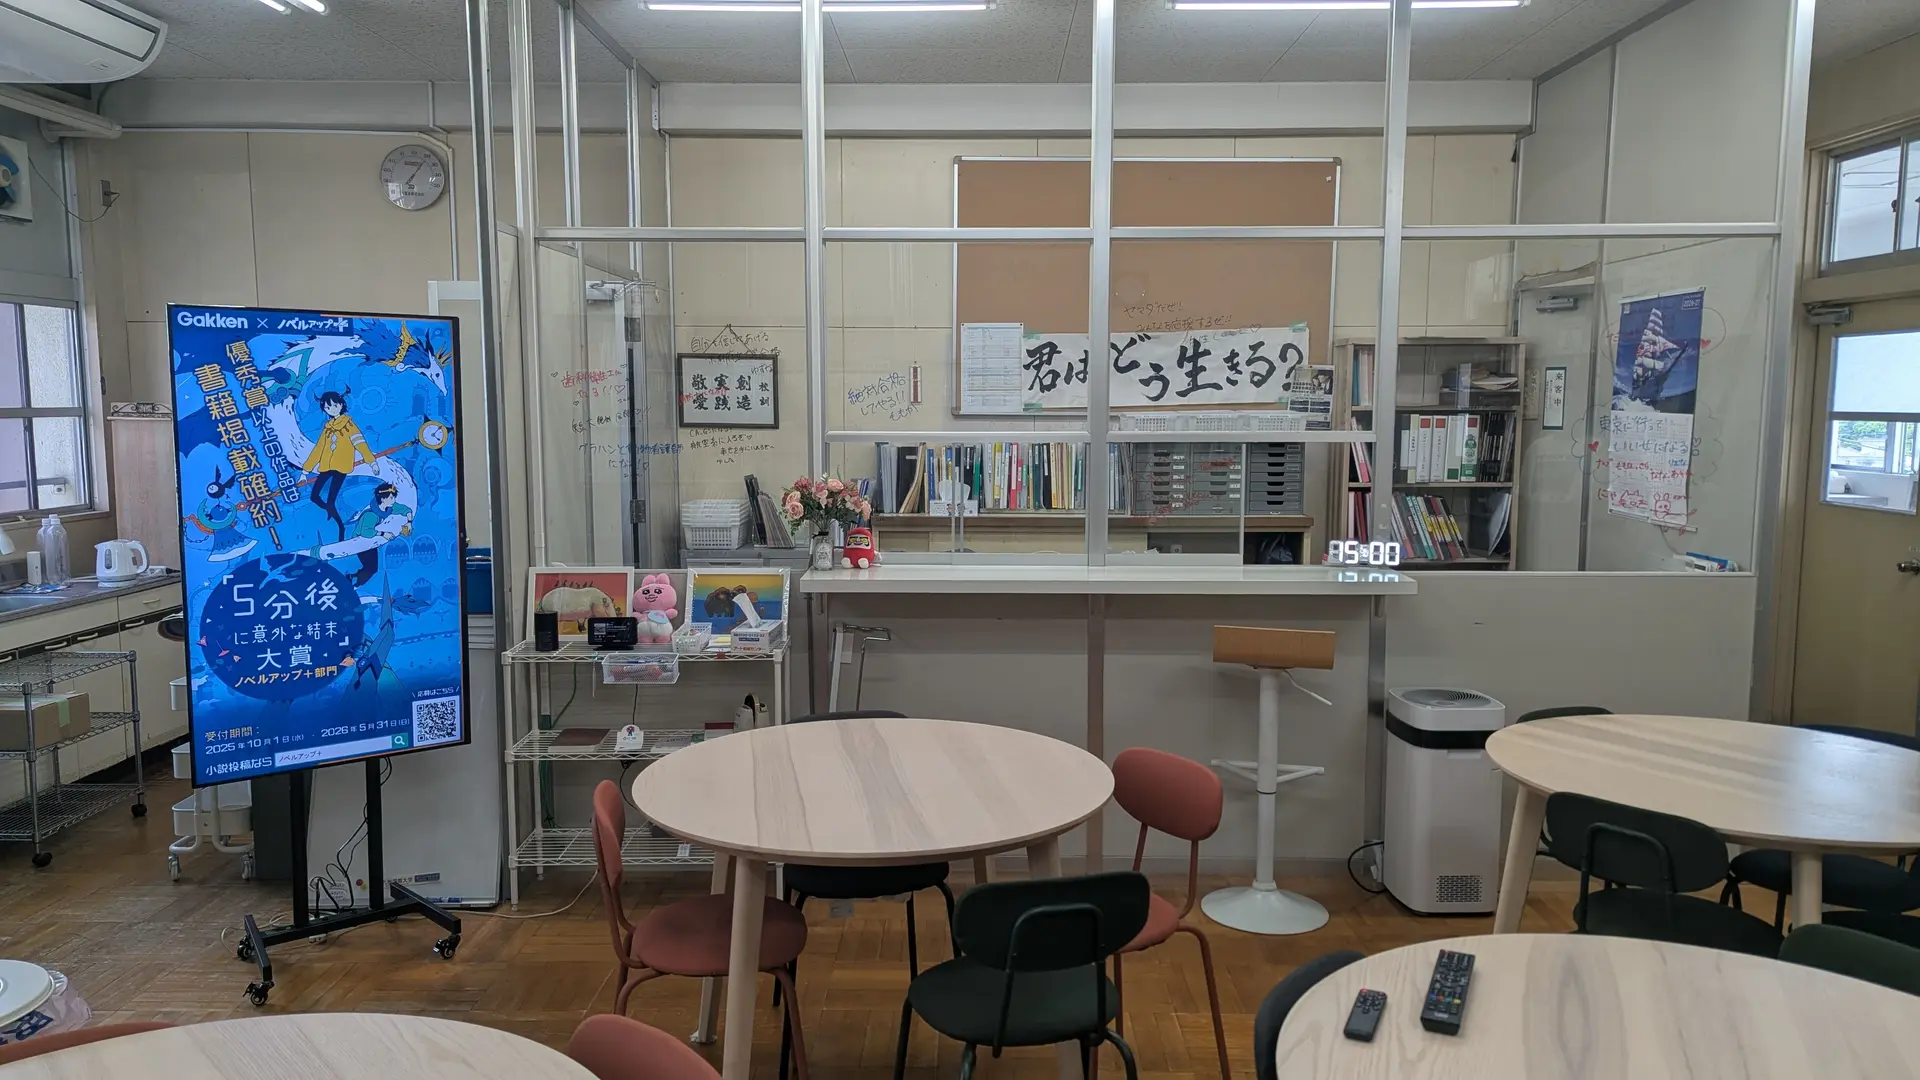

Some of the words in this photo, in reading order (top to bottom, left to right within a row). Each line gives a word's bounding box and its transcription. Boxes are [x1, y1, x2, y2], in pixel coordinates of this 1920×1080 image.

[177, 311, 248, 329] Gakken
[692, 374, 709, 411] 敬愛
[735, 374, 752, 411] 創造
[257, 645, 313, 671] 大賞
[206, 756, 272, 776] 小説投稿なら
